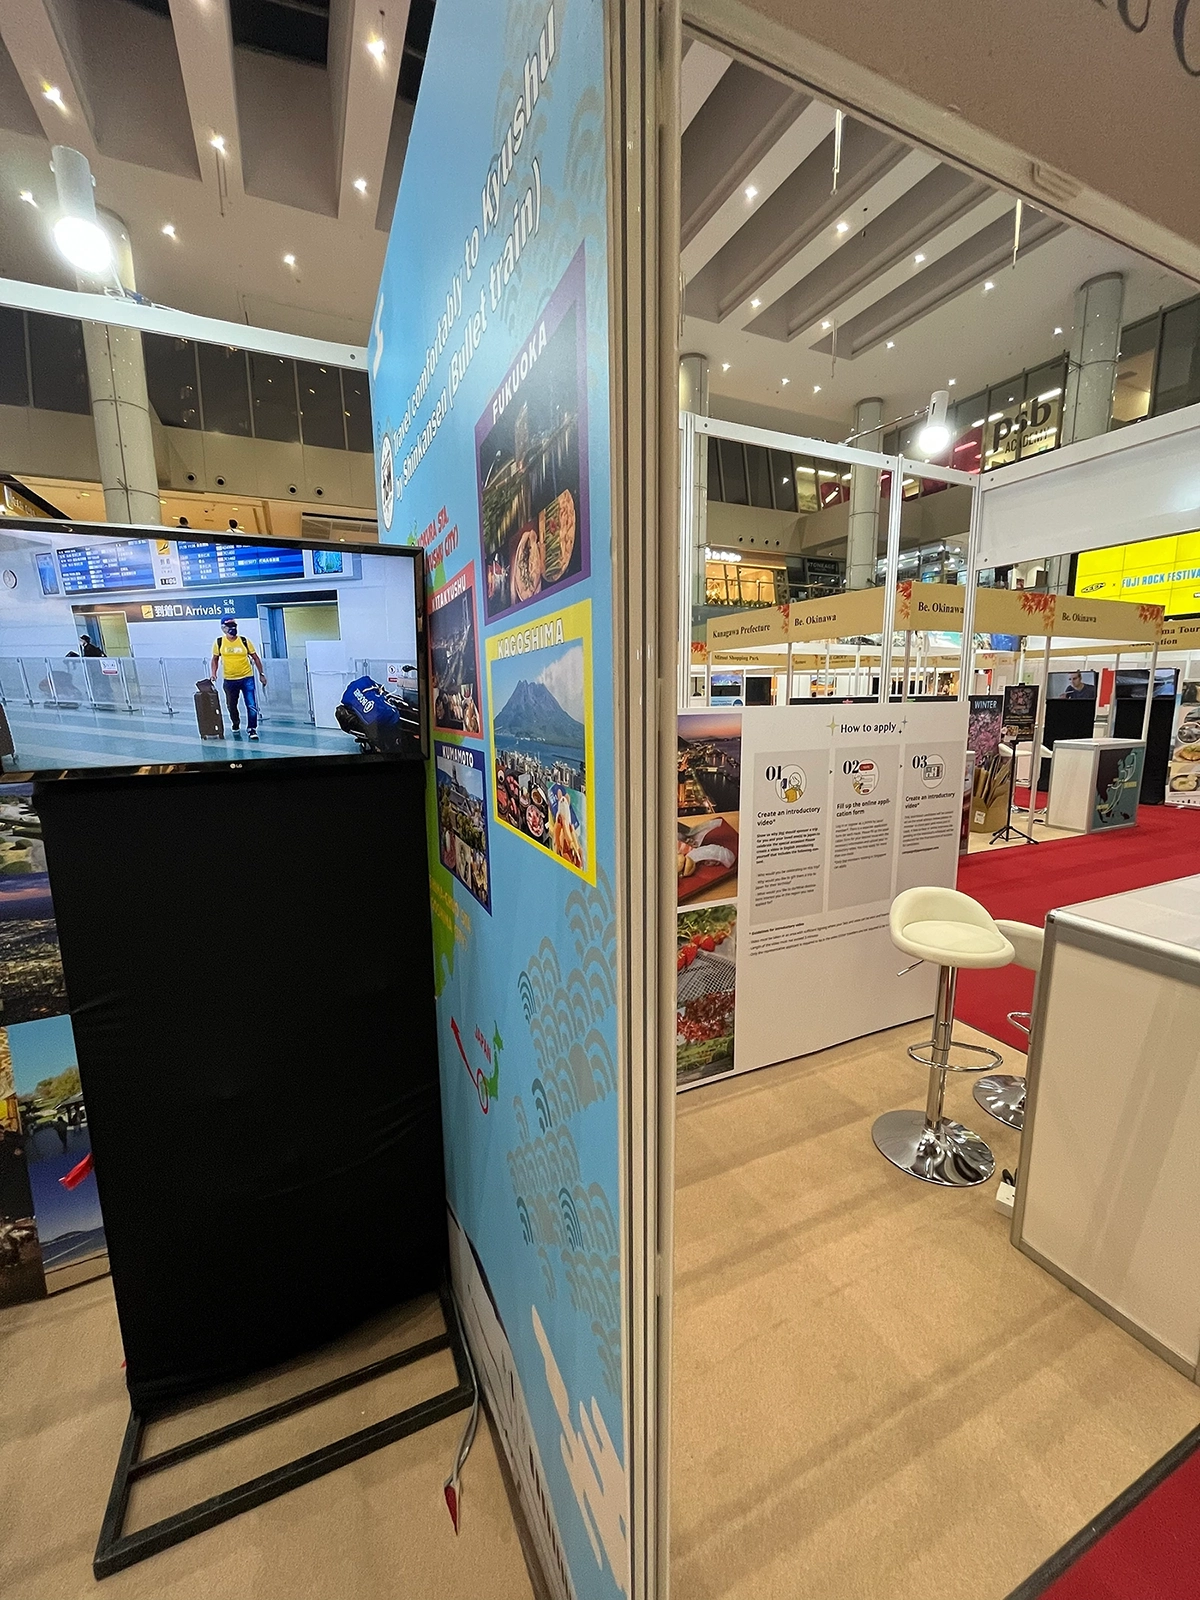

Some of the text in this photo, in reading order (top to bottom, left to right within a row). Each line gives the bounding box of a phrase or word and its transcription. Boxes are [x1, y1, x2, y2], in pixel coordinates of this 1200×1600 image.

[393, 3, 555, 458] Travel comfortably to Kyushu
[403, 386, 448, 488] Shinkansen
[448, 284, 488, 410] (Bullet
[489, 156, 541, 313] train)
[492, 320, 547, 425] FUKUOKA
[993, 397, 1051, 453] psb
[1121, 578, 1140, 589] FUJI
[1141, 573, 1165, 586] ROCK
[432, 574, 467, 613] KITAKYUSHU
[185, 604, 222, 616] Arrivals
[918, 602, 964, 613] Be. Okinawa
[794, 614, 837, 626] Be. Okinawa
[1062, 612, 1097, 623] Be. Okinawa
[740, 624, 770, 636] Prefecture
[497, 617, 564, 660] KAGOSHIMA
[974, 701, 997, 709] WINTER
[840, 722, 897, 733] How to apply
[442, 746, 474, 768] KUMAMOTO
[912, 755, 927, 769] 03
[766, 766, 781, 781] 01
[843, 760, 860, 774] 02
[928, 792, 955, 800] introductory
[786, 807, 820, 815] introductory
[475, 1024, 491, 1064] JAPAN
